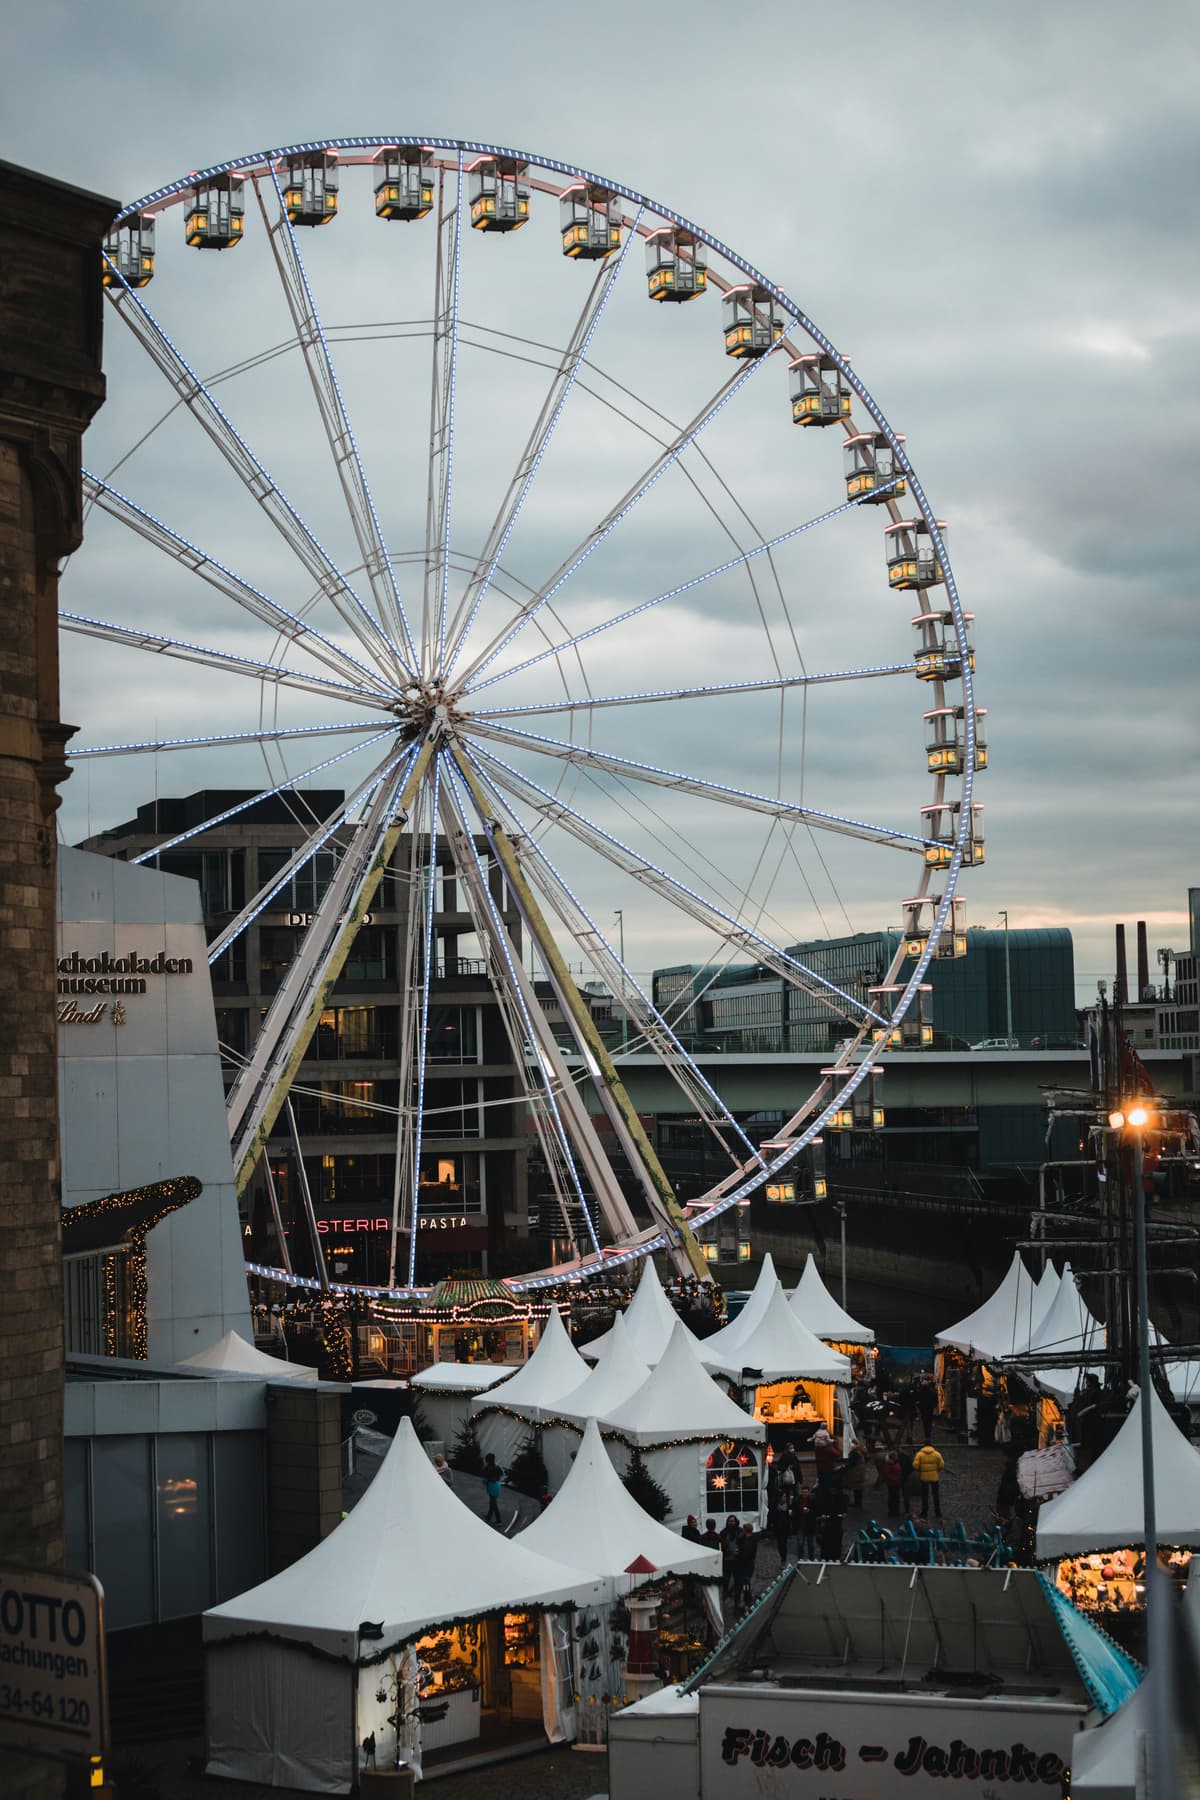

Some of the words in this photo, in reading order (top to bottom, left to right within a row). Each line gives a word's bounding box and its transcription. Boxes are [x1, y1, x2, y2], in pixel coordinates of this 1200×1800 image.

[419, 1217, 468, 1231] PASTA
[721, 1726, 847, 1772] Fisch
[893, 1735, 1064, 1785] Jahnke
